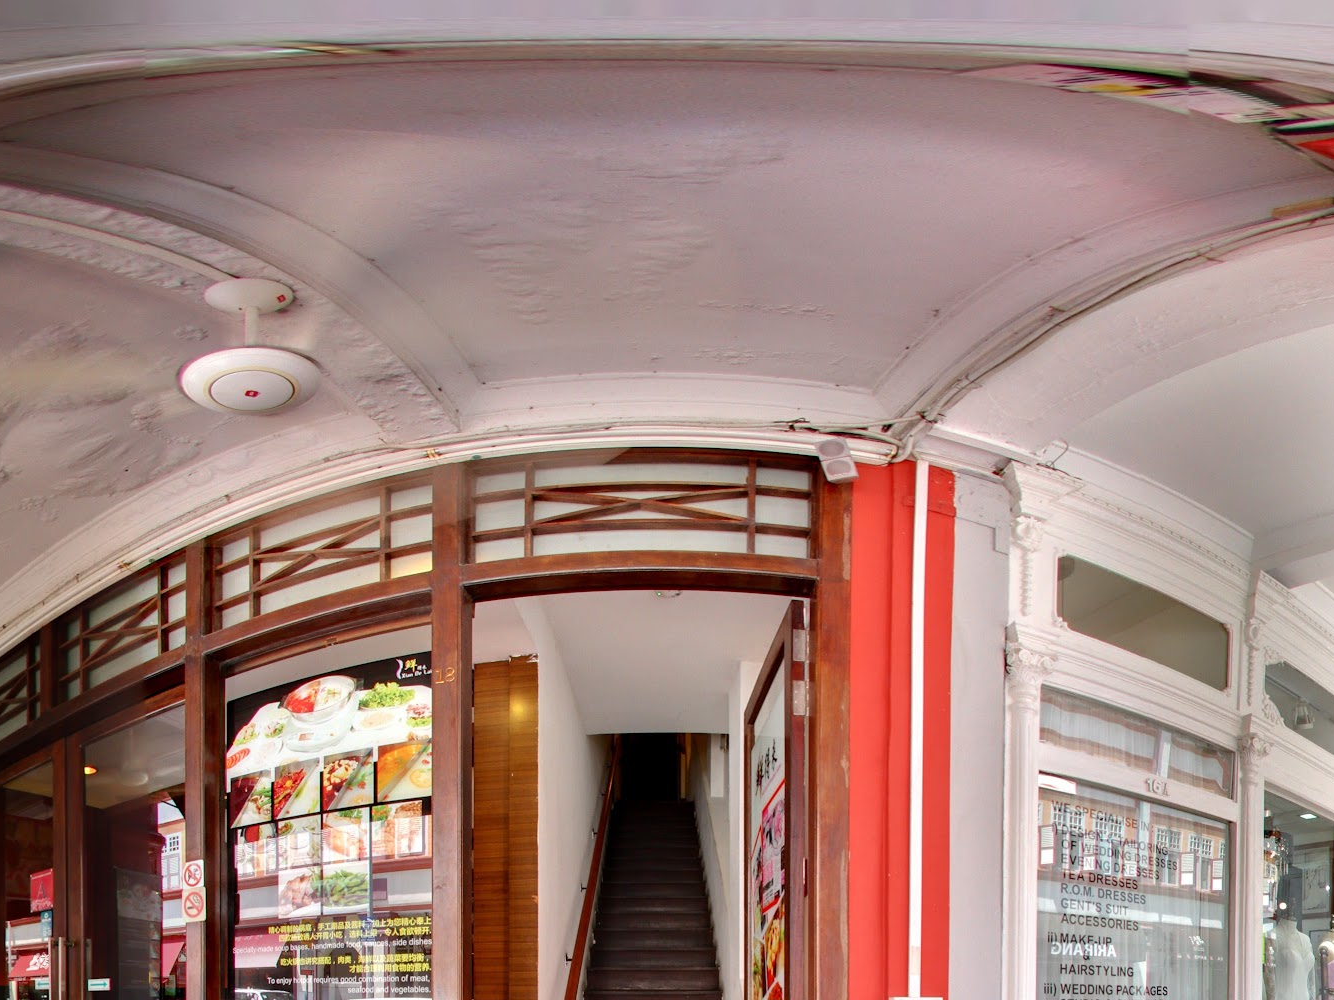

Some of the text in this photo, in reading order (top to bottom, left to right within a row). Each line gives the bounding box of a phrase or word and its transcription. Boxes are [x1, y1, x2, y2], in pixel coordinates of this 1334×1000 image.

[435, 667, 455, 684] 18
[1052, 800, 1071, 813] WE
[1075, 805, 1138, 829] SPECIALISE
[1061, 824, 1103, 843] DESIGN
[1061, 838, 1178, 870] OF WEDDING DRESSES
[1061, 853, 1160, 880] EVENING DRESSES
[1062, 870, 1138, 890] TEA DRESSES
[1061, 882, 1146, 904] R.O.M. DRESSES
[1061, 898, 1129, 916] GENT'S SUIT
[1061, 913, 1139, 931] ACCESSORIES
[312, 941, 344, 950] handmade
[346, 939, 362, 949] food,
[393, 937, 407, 946] side
[409, 937, 432, 946] dishes
[1060, 933, 1112, 946] MAKE-UP
[1060, 964, 1134, 977] HAIRSTYLING
[267, 977, 276, 985] To
[276, 977, 292, 986] enjoy
[313, 976, 339, 985] requires
[340, 976, 357, 985] good
[358, 975, 400, 983] combination
[410, 975, 430, 984] meat,
[348, 986, 375, 994] seafood
[391, 985, 431, 995] vegetables.
[1043, 984, 1169, 997] iii) WEDDING PACKAGES
